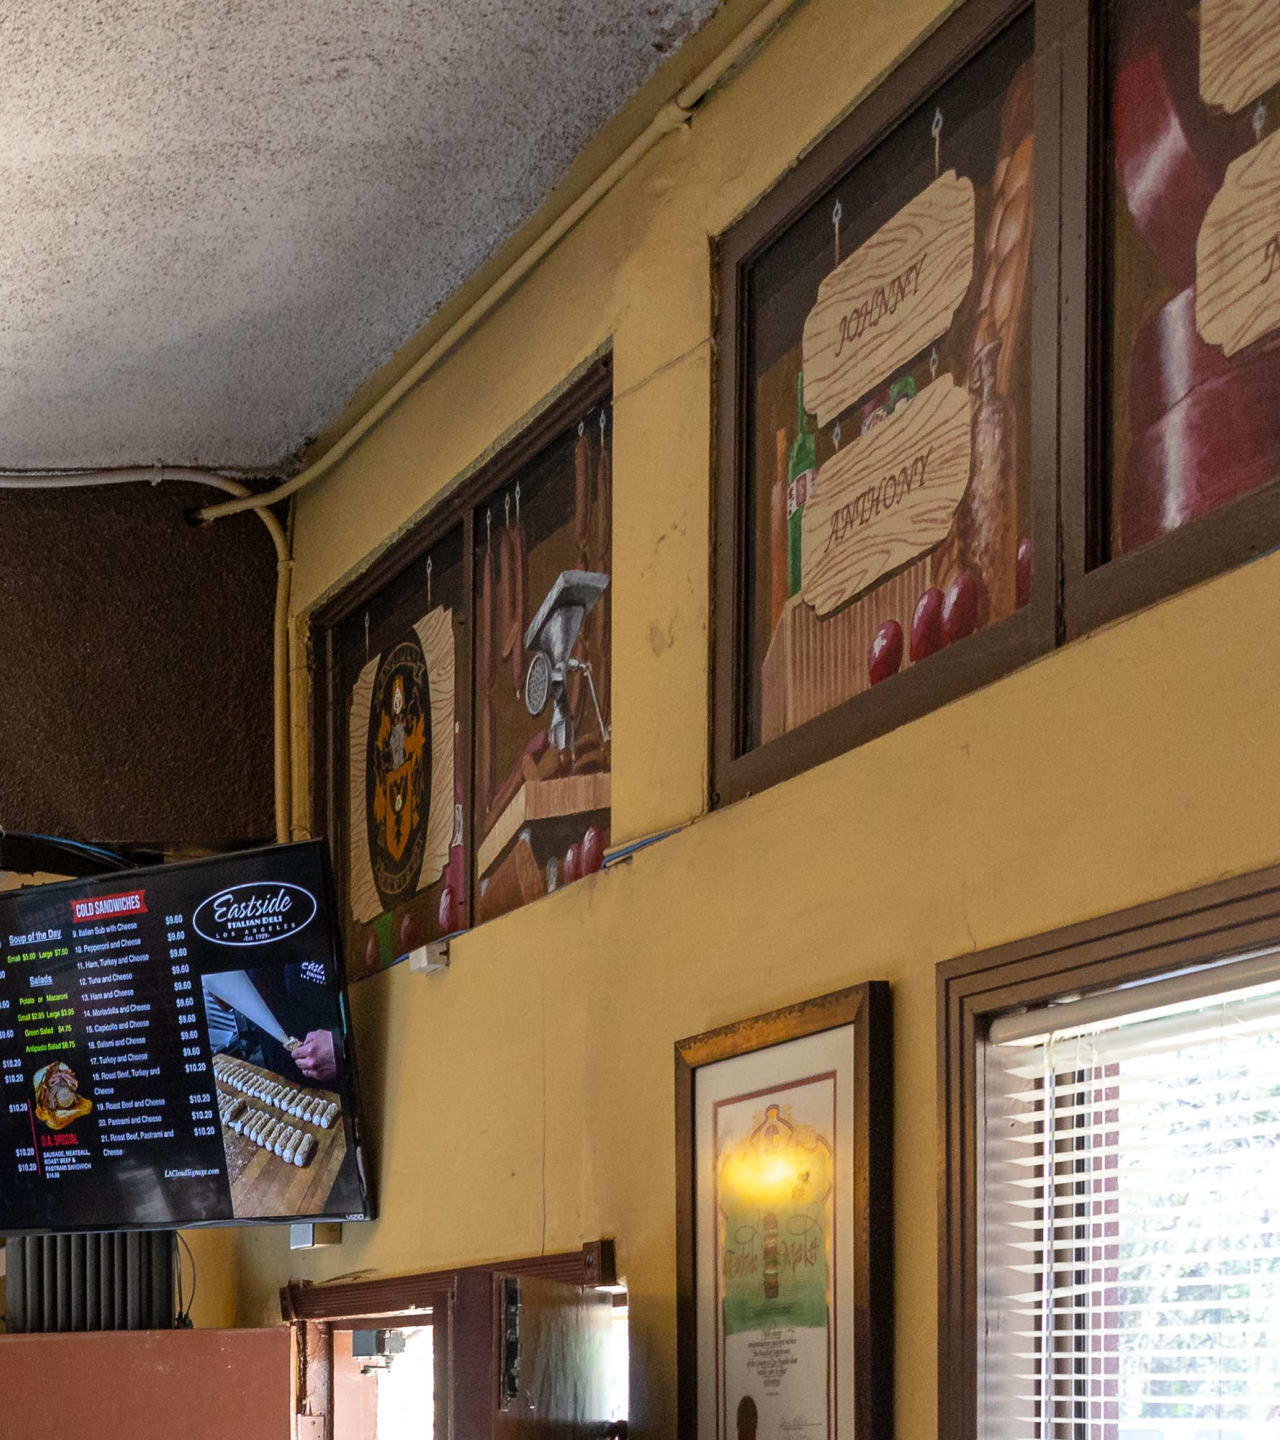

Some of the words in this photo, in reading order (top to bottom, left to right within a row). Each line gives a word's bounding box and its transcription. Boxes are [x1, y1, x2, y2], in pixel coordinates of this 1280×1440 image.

[835, 253, 927, 358] JOHNNY
[824, 447, 933, 553] ANTHONY
[76, 903, 93, 918] COLD
[95, 895, 140, 914] SANDWICHES
[214, 889, 292, 922] Eastside
[228, 919, 260, 929] ITALIAN
[262, 916, 282, 924] DELI
[9, 935, 26, 945] Soup
[28, 932, 35, 941] of
[36, 931, 46, 940] the
[48, 929, 61, 939] Day
[30, 975, 53, 986] Salads
[189, 1093, 211, 1104] $10.20
[192, 1110, 213, 1120] $10.20
[194, 1126, 215, 1136] $10.20
